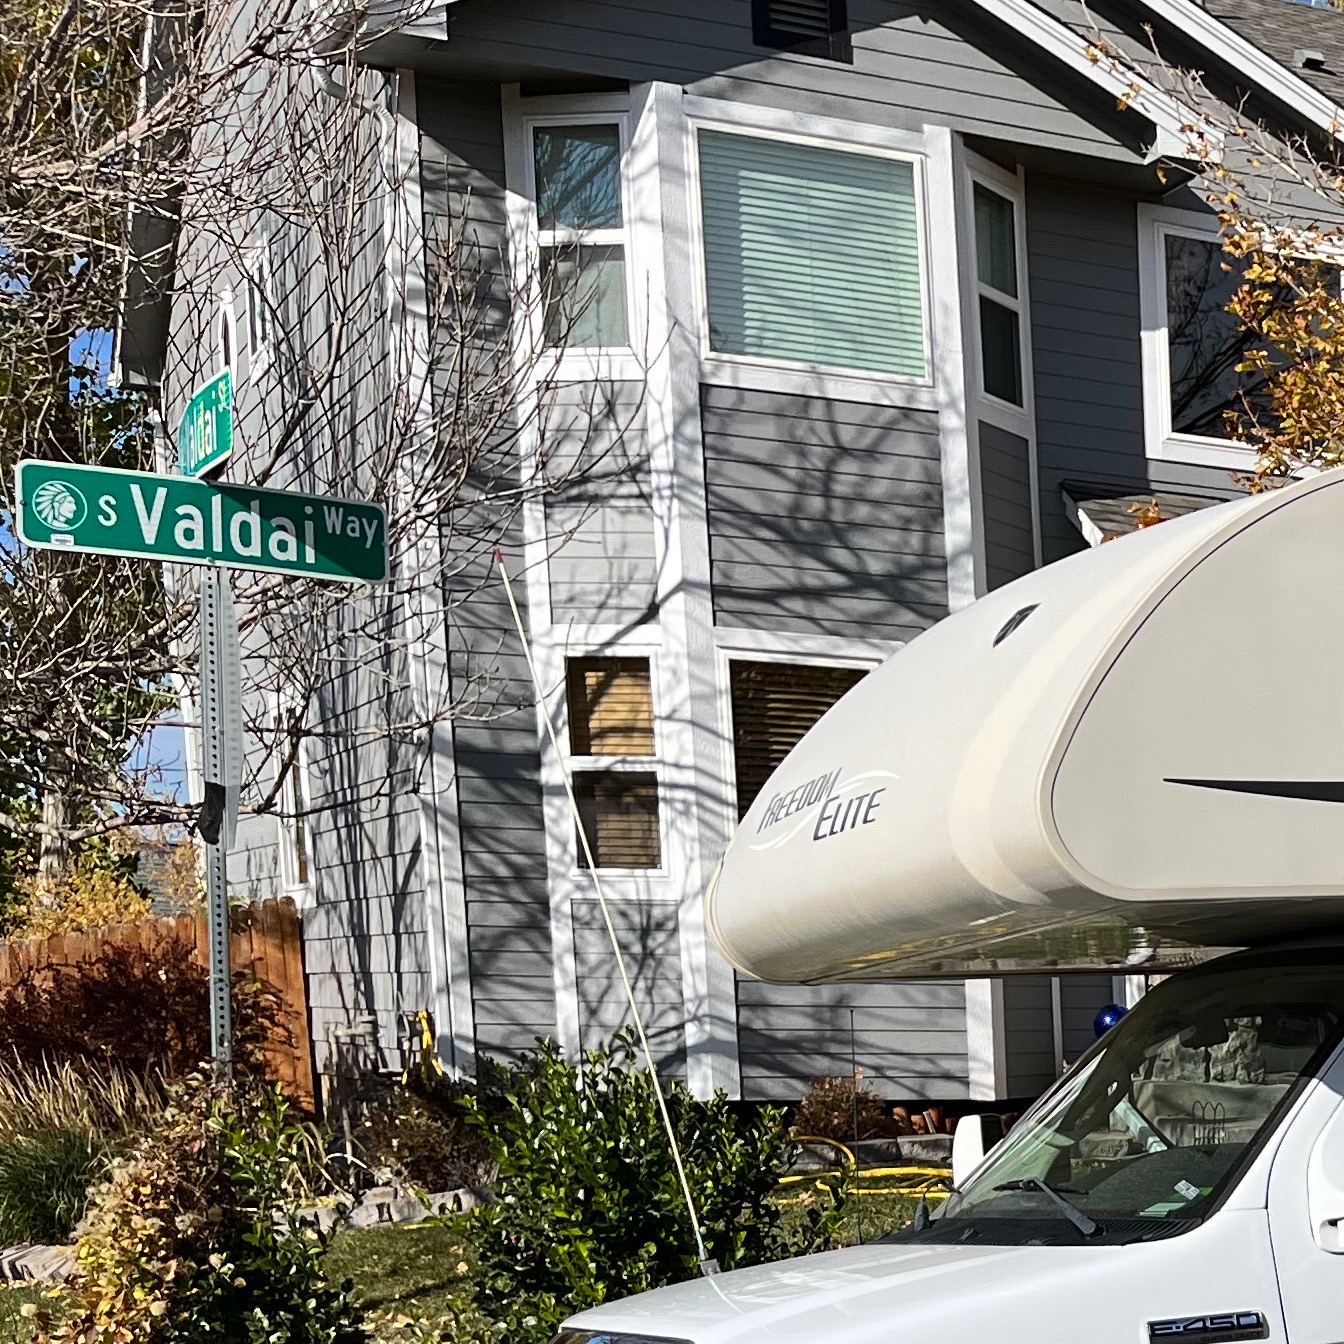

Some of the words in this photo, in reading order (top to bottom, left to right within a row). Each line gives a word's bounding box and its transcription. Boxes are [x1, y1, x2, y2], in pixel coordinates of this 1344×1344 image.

[98, 494, 117, 527] S
[129, 483, 316, 564] Valdai
[323, 505, 378, 549] Way
[756, 767, 842, 834] FREEDOM
[813, 787, 887, 841] ELITE
